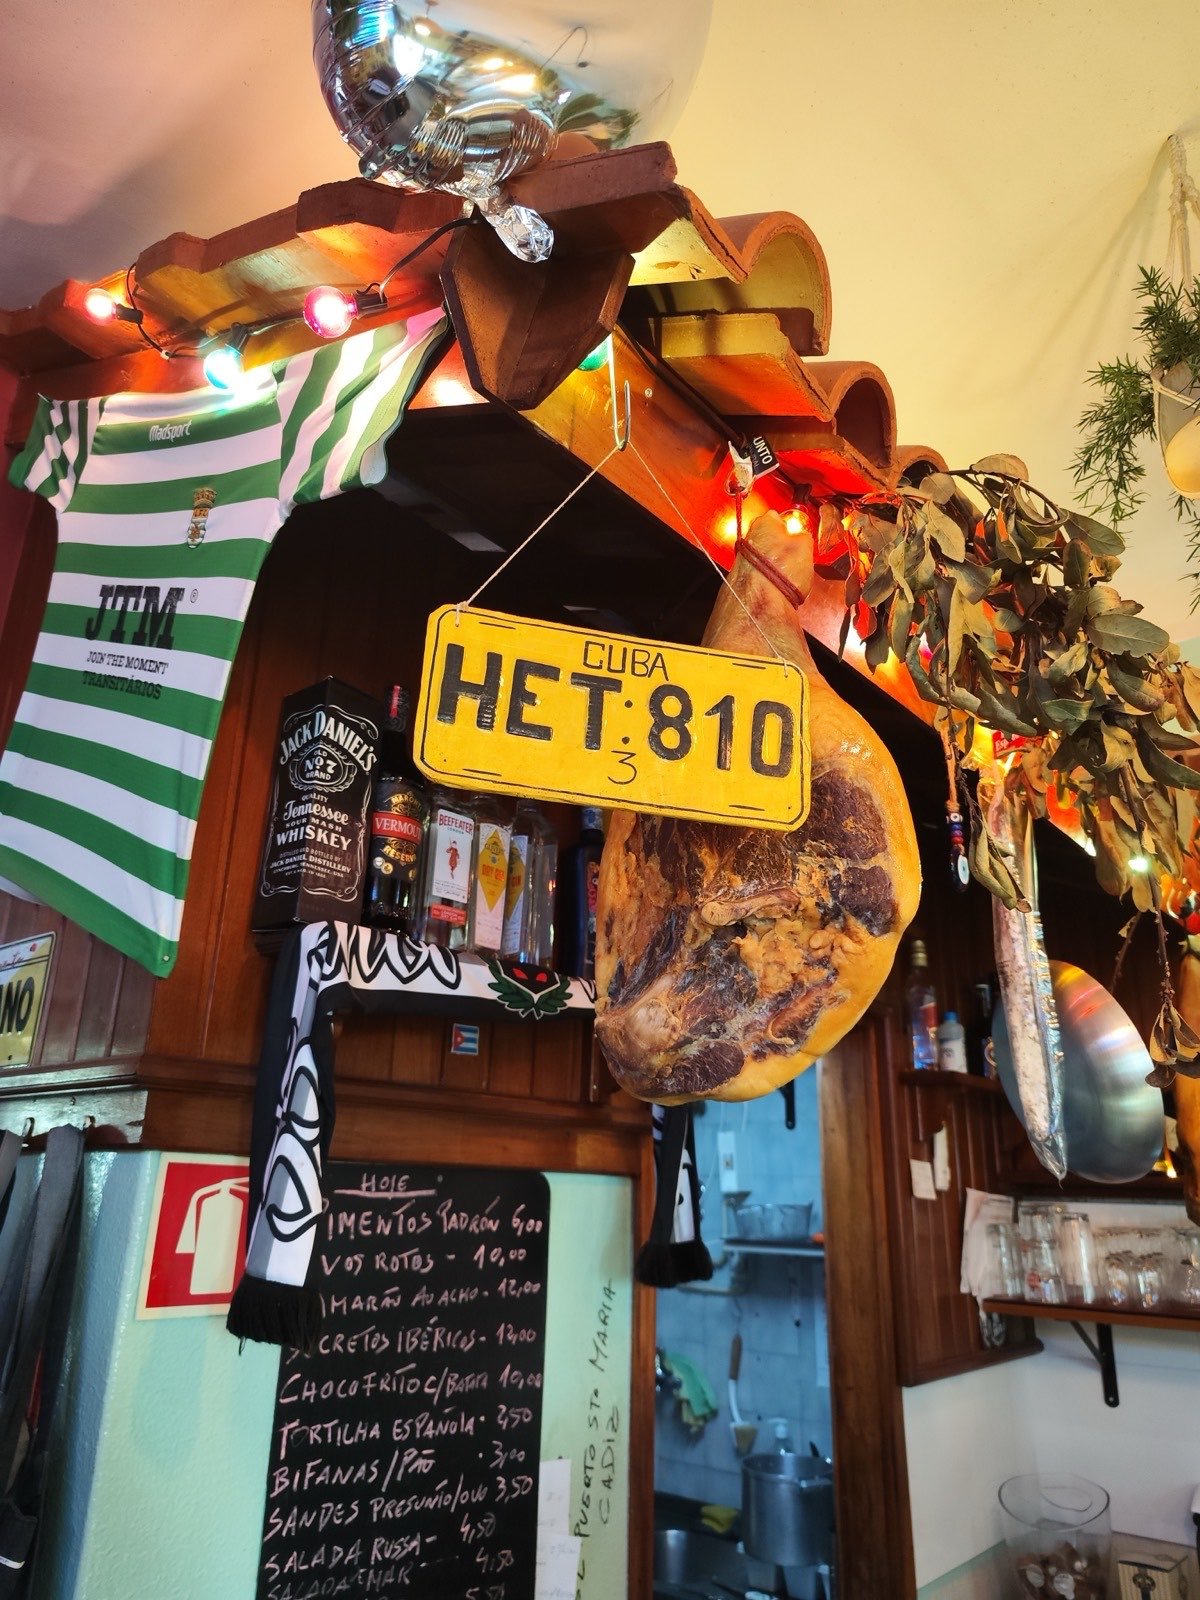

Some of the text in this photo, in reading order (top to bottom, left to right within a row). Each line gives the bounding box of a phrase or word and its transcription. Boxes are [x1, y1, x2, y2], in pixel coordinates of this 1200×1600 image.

[150, 420, 192, 442] Madsport
[85, 585, 185, 650] JTM
[87, 651, 169, 675] JOIN THE MOMENT
[582, 640, 669, 681] CUBA
[82, 670, 162, 700] TRANSITÁRIOS
[280, 710, 377, 772] JACK DANIEL'S
[305, 771, 332, 781] BRAND
[607, 750, 638, 785] 3
[283, 800, 349, 826] Tennessee
[301, 792, 329, 803] QUALITY
[276, 824, 352, 851] WHISKEY
[285, 817, 342, 832] SOUR MASH
[438, 813, 473, 834] BEEFEATER
[270, 860, 285, 869] JACK
[284, 853, 307, 864] DANIEL
[309, 854, 352, 874] DISTILLERY
[0, 976, 35, 1034] NO
[511, 1203, 543, 1237] 6,00
[320, 1244, 526, 1276] VOS ROTOS 10,00
[588, 1278, 616, 1372] MARIA
[279, 1418, 381, 1461] TORTILHA
[489, 1440, 526, 1469] 3,00
[599, 1405, 619, 1524] CADIZ
[263, 1501, 359, 1543] SANDES
[495, 1475, 534, 1504] 3,50
[264, 1538, 362, 1583] SALADA
